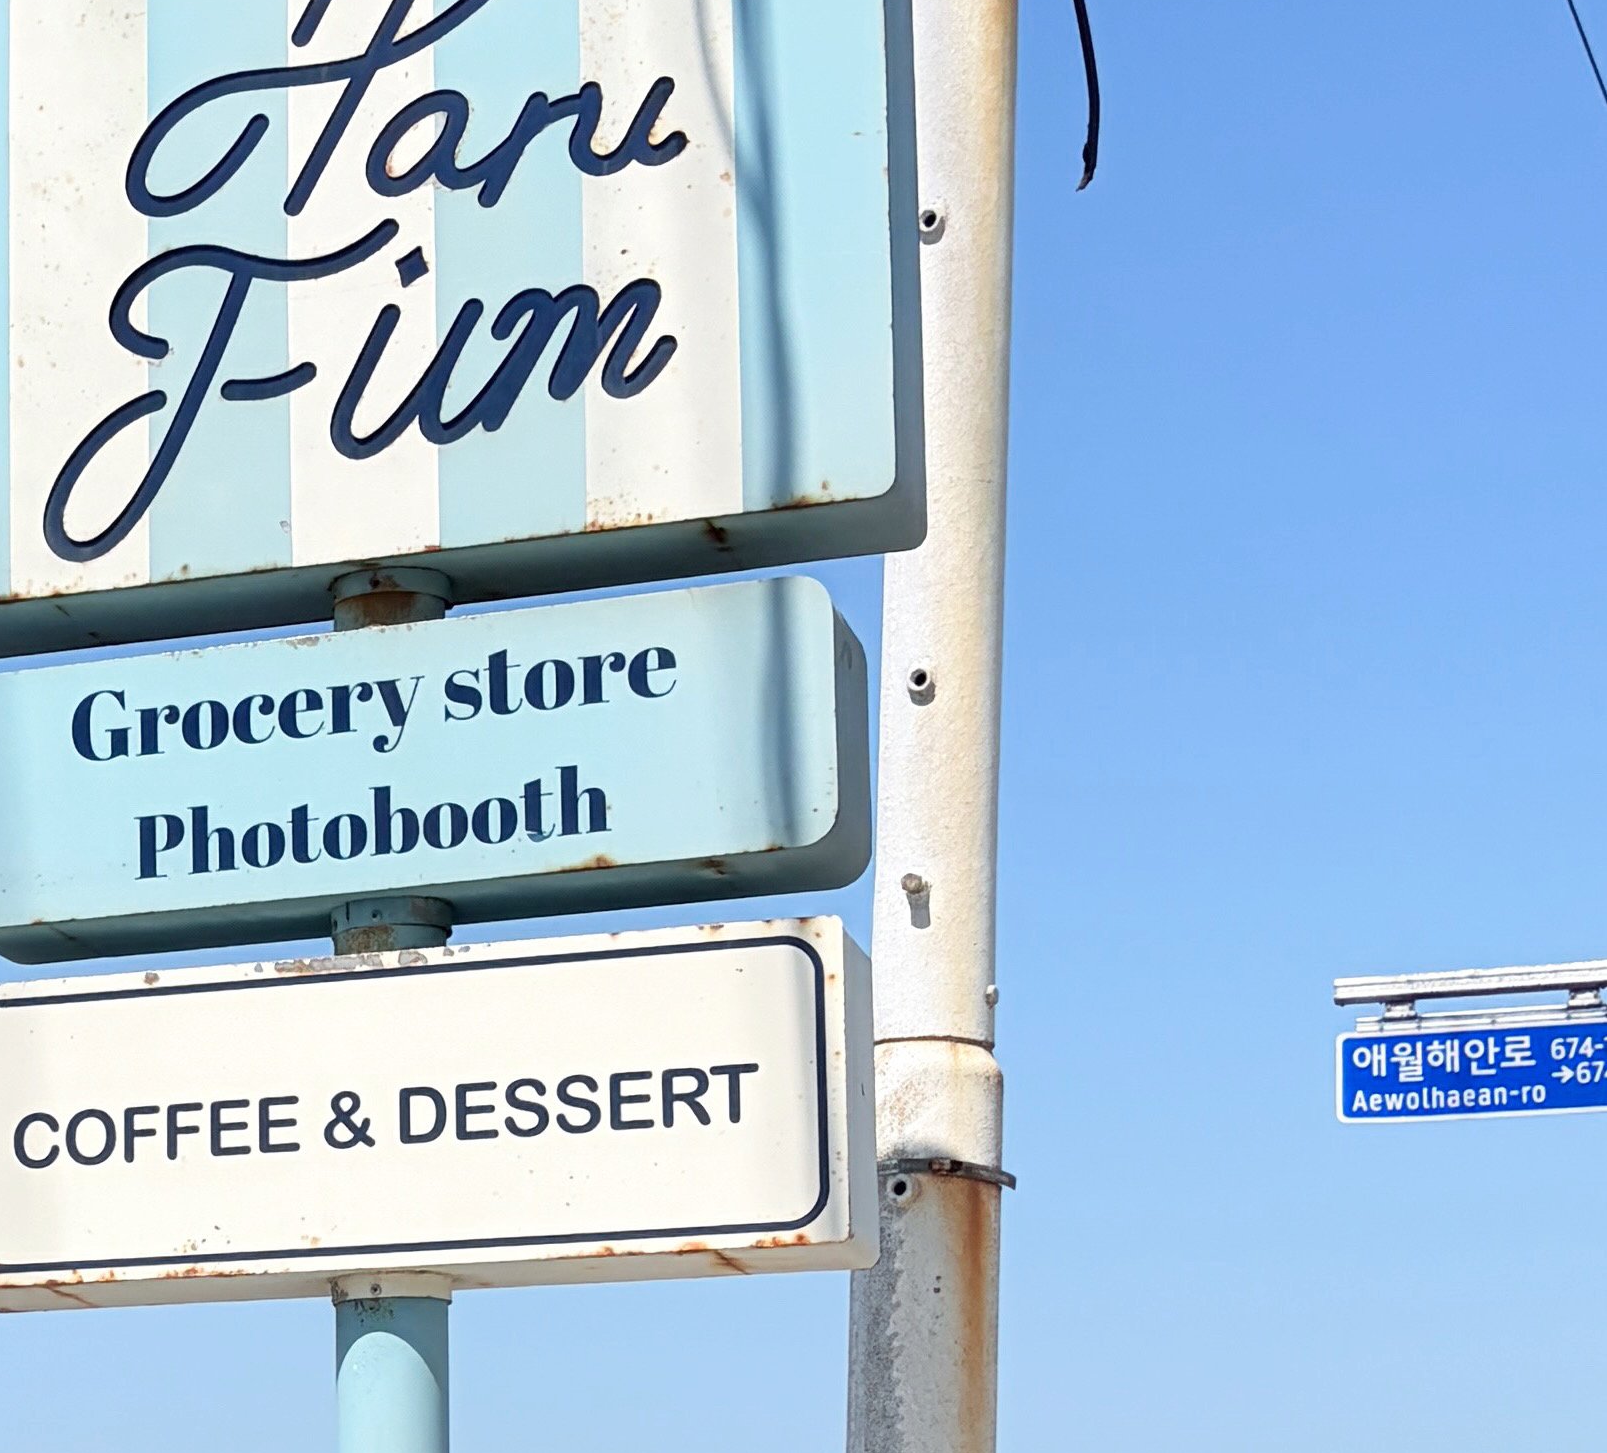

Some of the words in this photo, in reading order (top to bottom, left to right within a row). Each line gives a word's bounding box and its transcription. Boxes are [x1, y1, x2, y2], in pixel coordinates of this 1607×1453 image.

[71, 676, 425, 762] Grocery
[444, 646, 677, 722] store
[133, 764, 612, 880] Photobooth
[1352, 1035, 1536, 1082] 애월해안로
[1550, 1036, 1607, 1060] 674-
[1576, 1060, 1607, 1084] 67
[13, 1095, 301, 1169] COFFEE
[323, 1090, 376, 1150] &
[399, 1063, 759, 1145] DESSERT
[1352, 1084, 1547, 1113] Aewolhaean-ro
